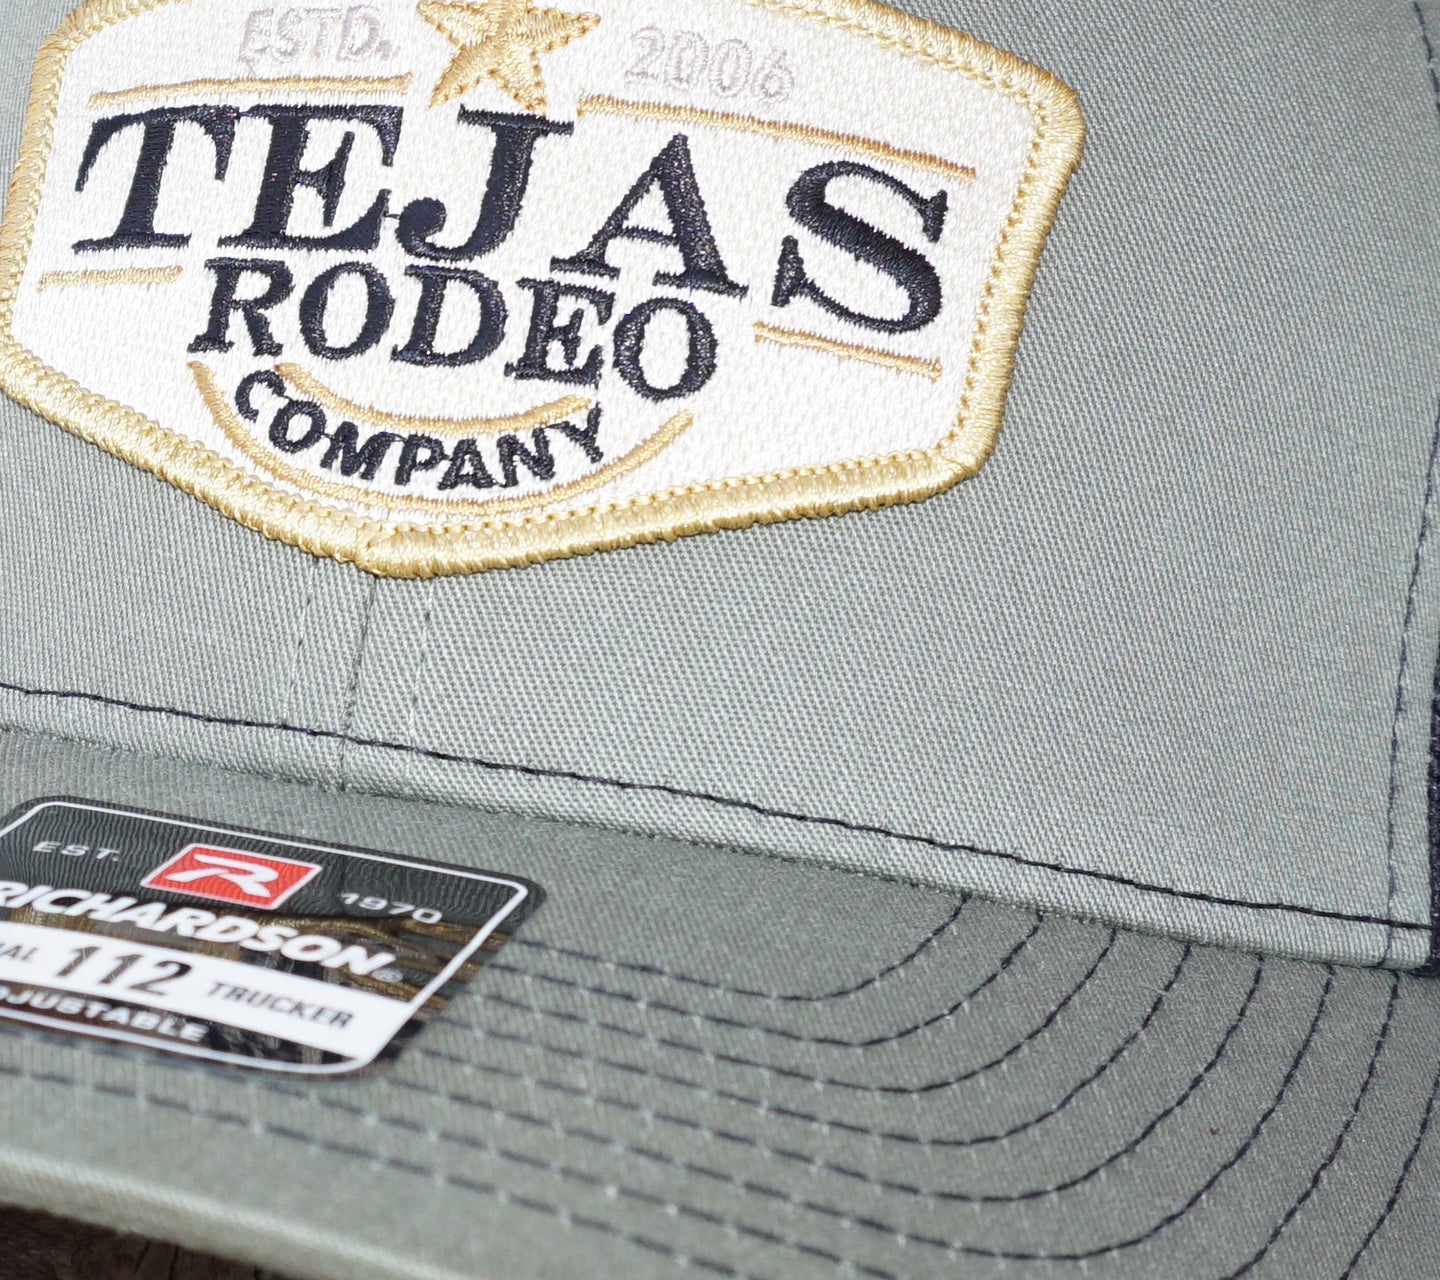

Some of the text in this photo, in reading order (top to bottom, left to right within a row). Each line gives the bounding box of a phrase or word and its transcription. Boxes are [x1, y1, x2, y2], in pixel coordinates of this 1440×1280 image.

[238, 5, 798, 101] ESTD. 2006
[72, 102, 948, 335] TEJAS
[186, 257, 720, 401] RODEO
[233, 369, 606, 490] COMPANY
[32, 840, 121, 862] EST.
[341, 893, 443, 924] 1970
[55, 945, 193, 997] 112
[208, 982, 354, 1030] TRUCKER
